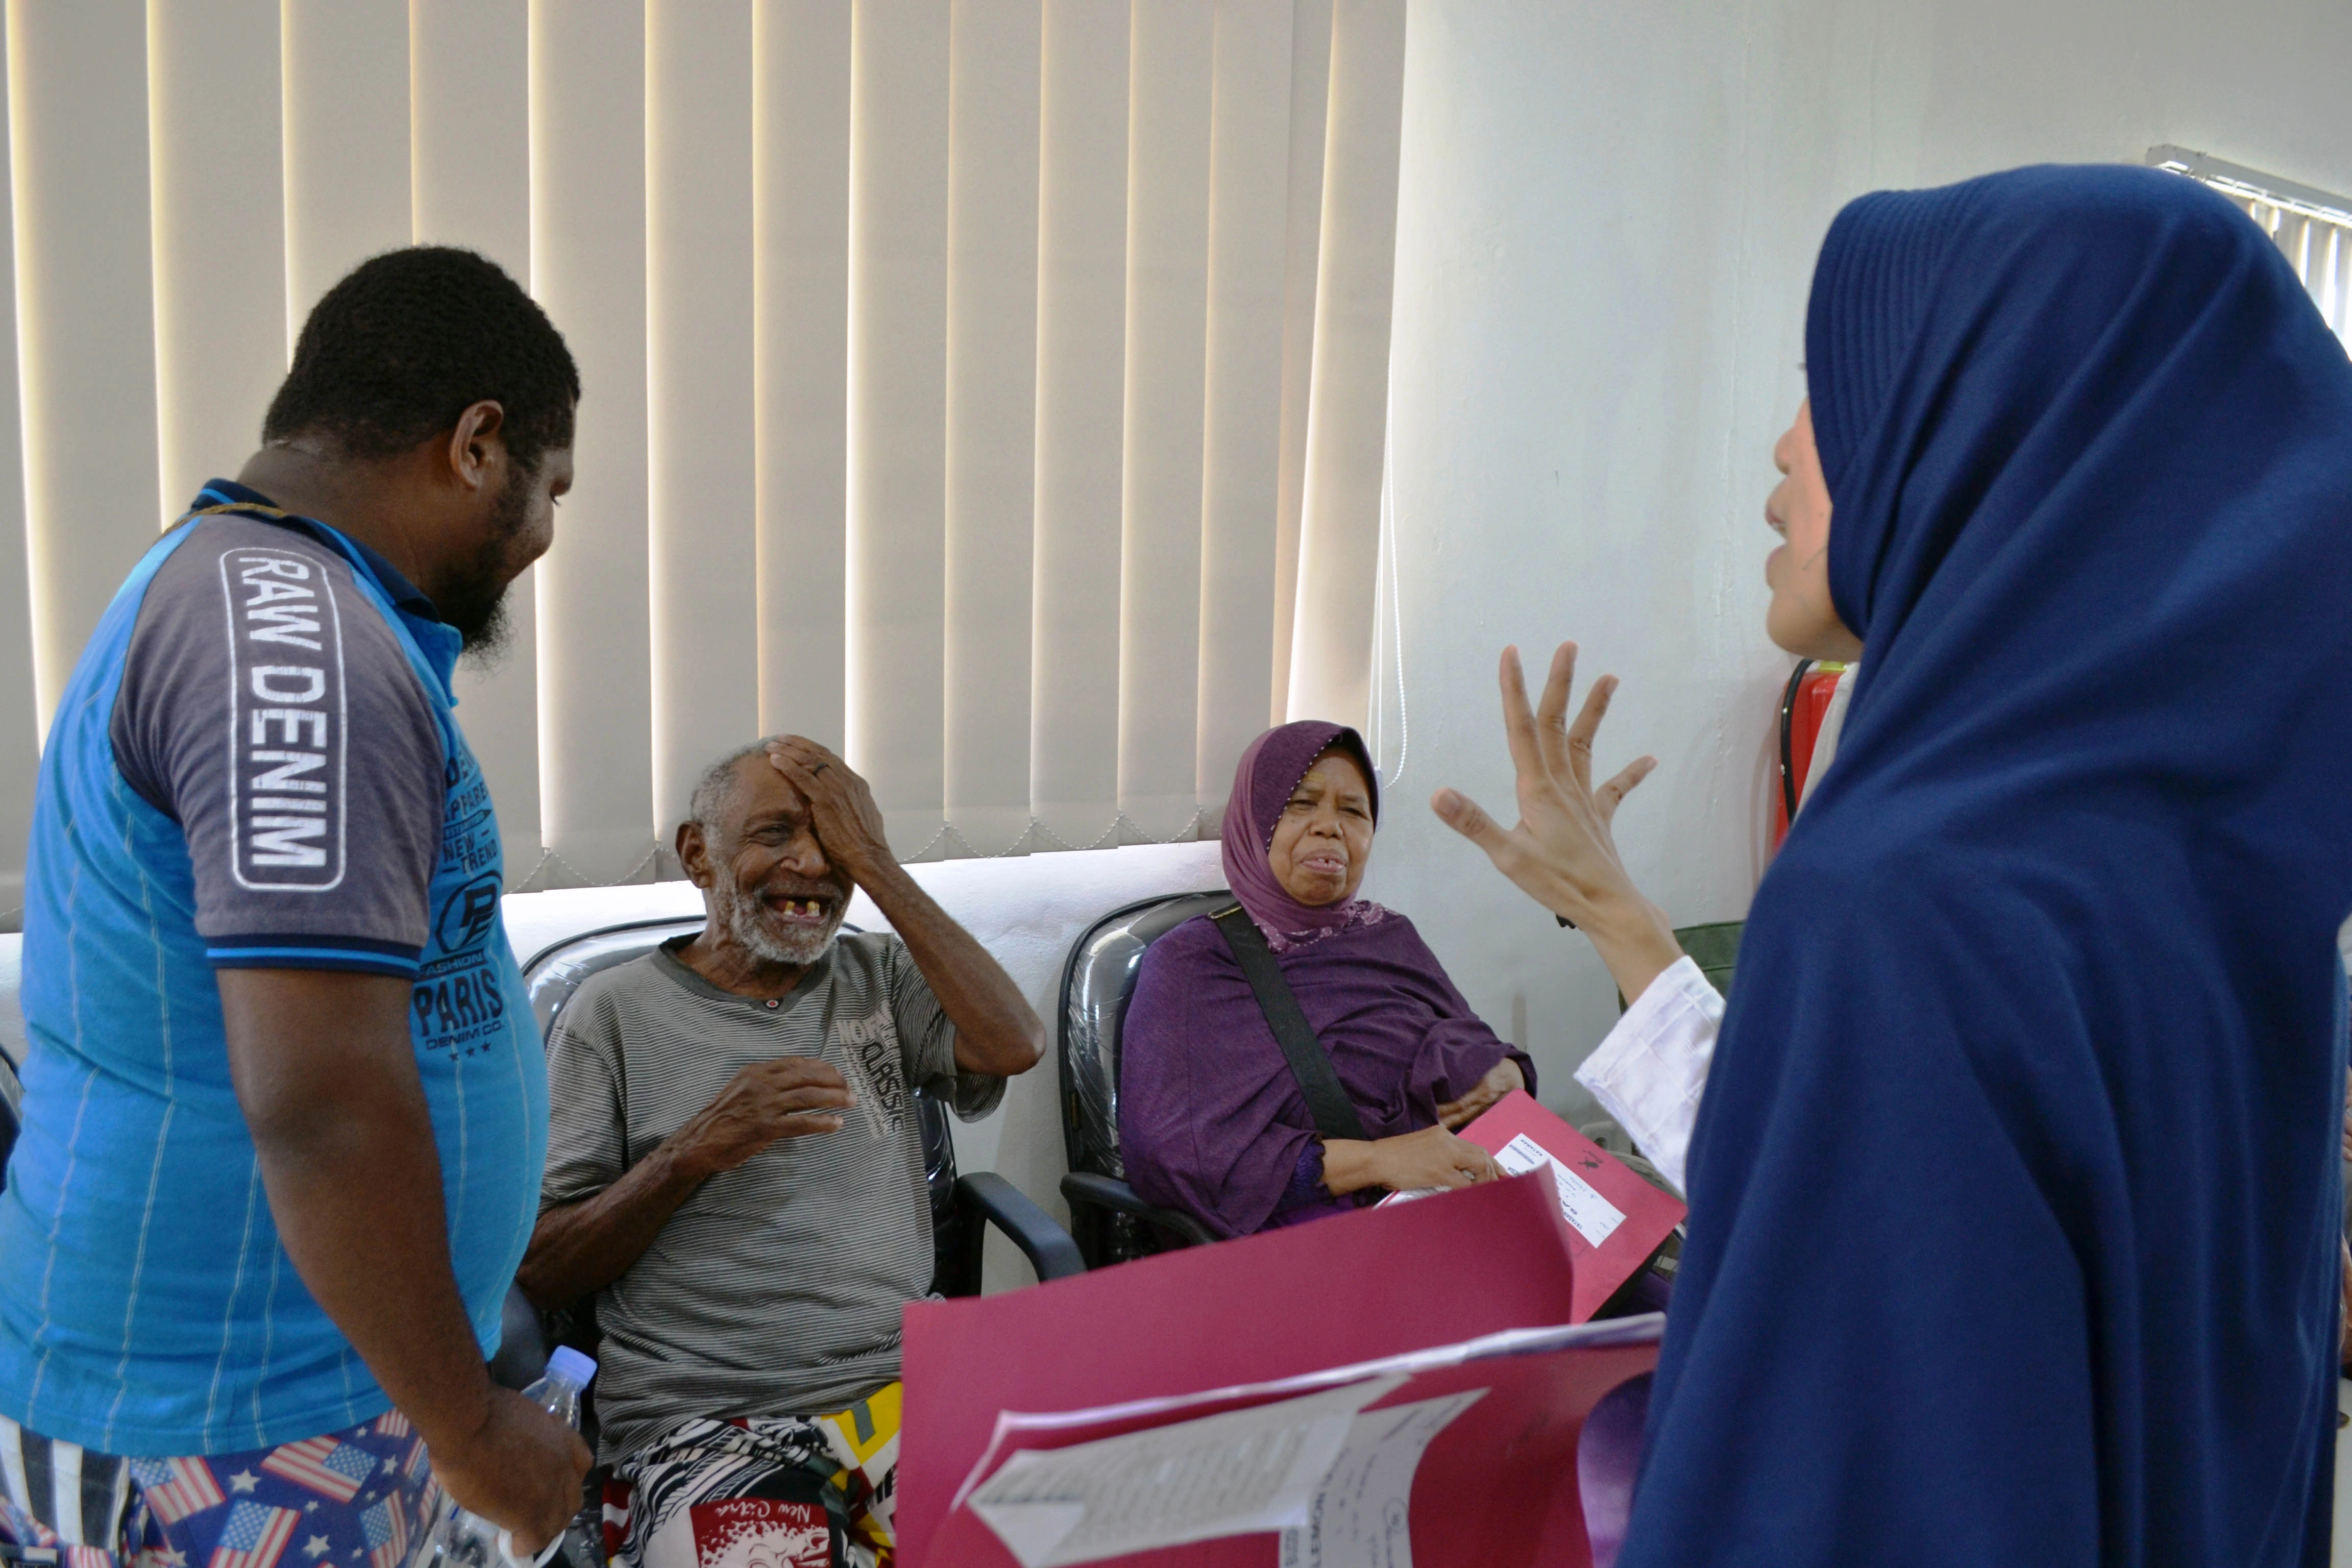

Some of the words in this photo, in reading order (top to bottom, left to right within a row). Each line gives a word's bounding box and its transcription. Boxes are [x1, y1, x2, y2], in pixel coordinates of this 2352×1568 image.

[239, 557, 322, 651] RAW
[252, 666, 327, 866] DENIM
[443, 781, 489, 823] PPARE
[443, 831, 475, 863] NEW
[460, 839, 498, 874] TREND
[413, 968, 503, 1037] PARIS
[426, 1027, 480, 1050] DENIM
[862, 1042, 904, 1132] CLASSIC
[778, 1503, 810, 1523] New
